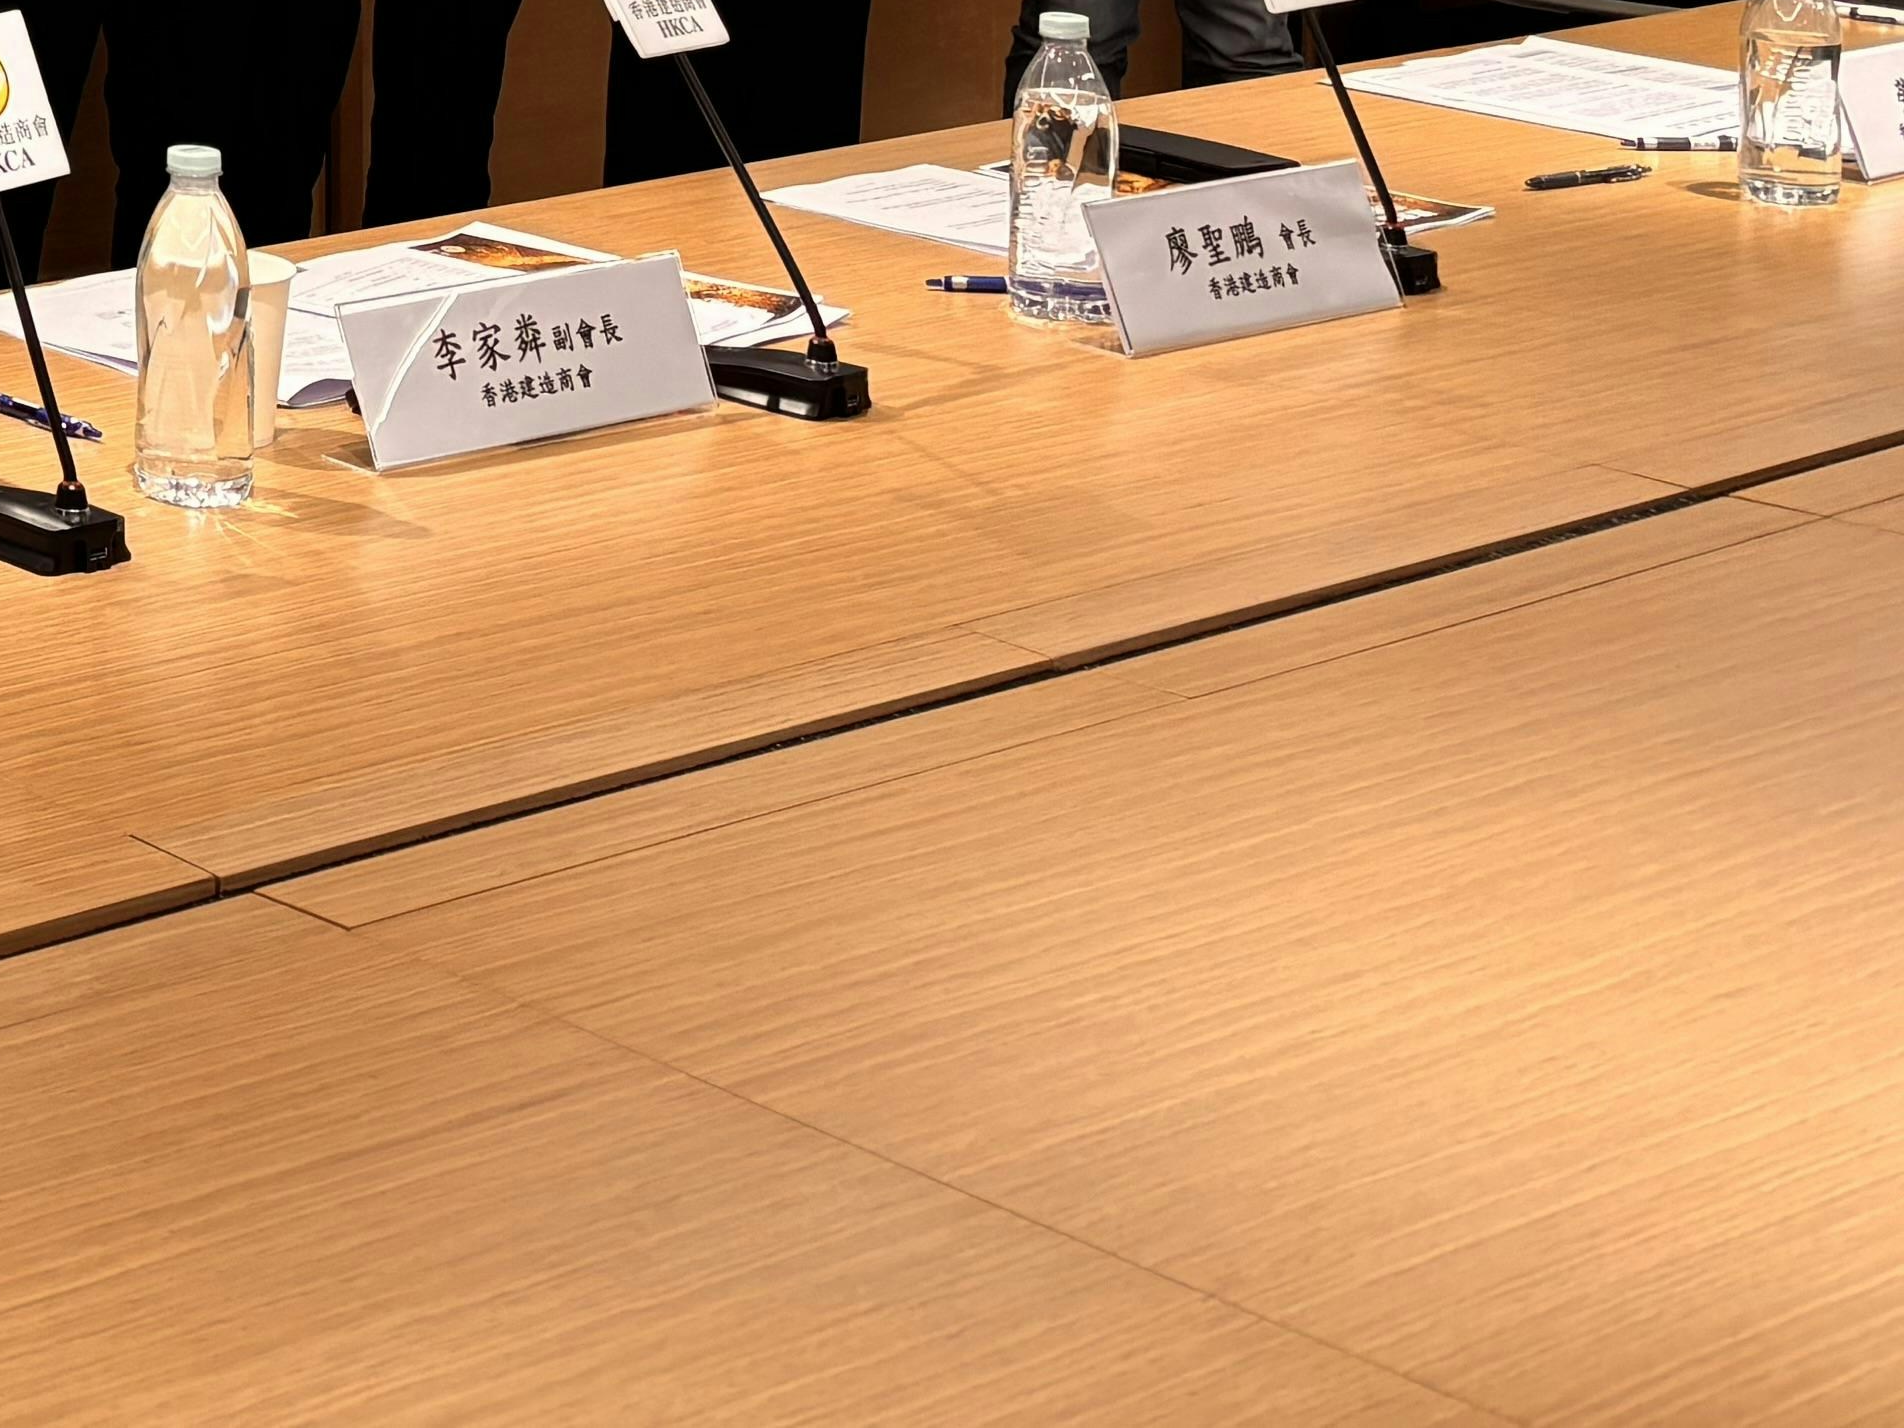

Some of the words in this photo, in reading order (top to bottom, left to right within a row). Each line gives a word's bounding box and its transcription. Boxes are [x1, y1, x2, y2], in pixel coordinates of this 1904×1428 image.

[657, 15, 704, 39] HKCA
[1165, 215, 1265, 276] 廖聖鵬
[1278, 218, 1318, 251] 會長
[1208, 263, 1299, 300] 香港建造商會
[481, 363, 593, 408] 香港建造商會
